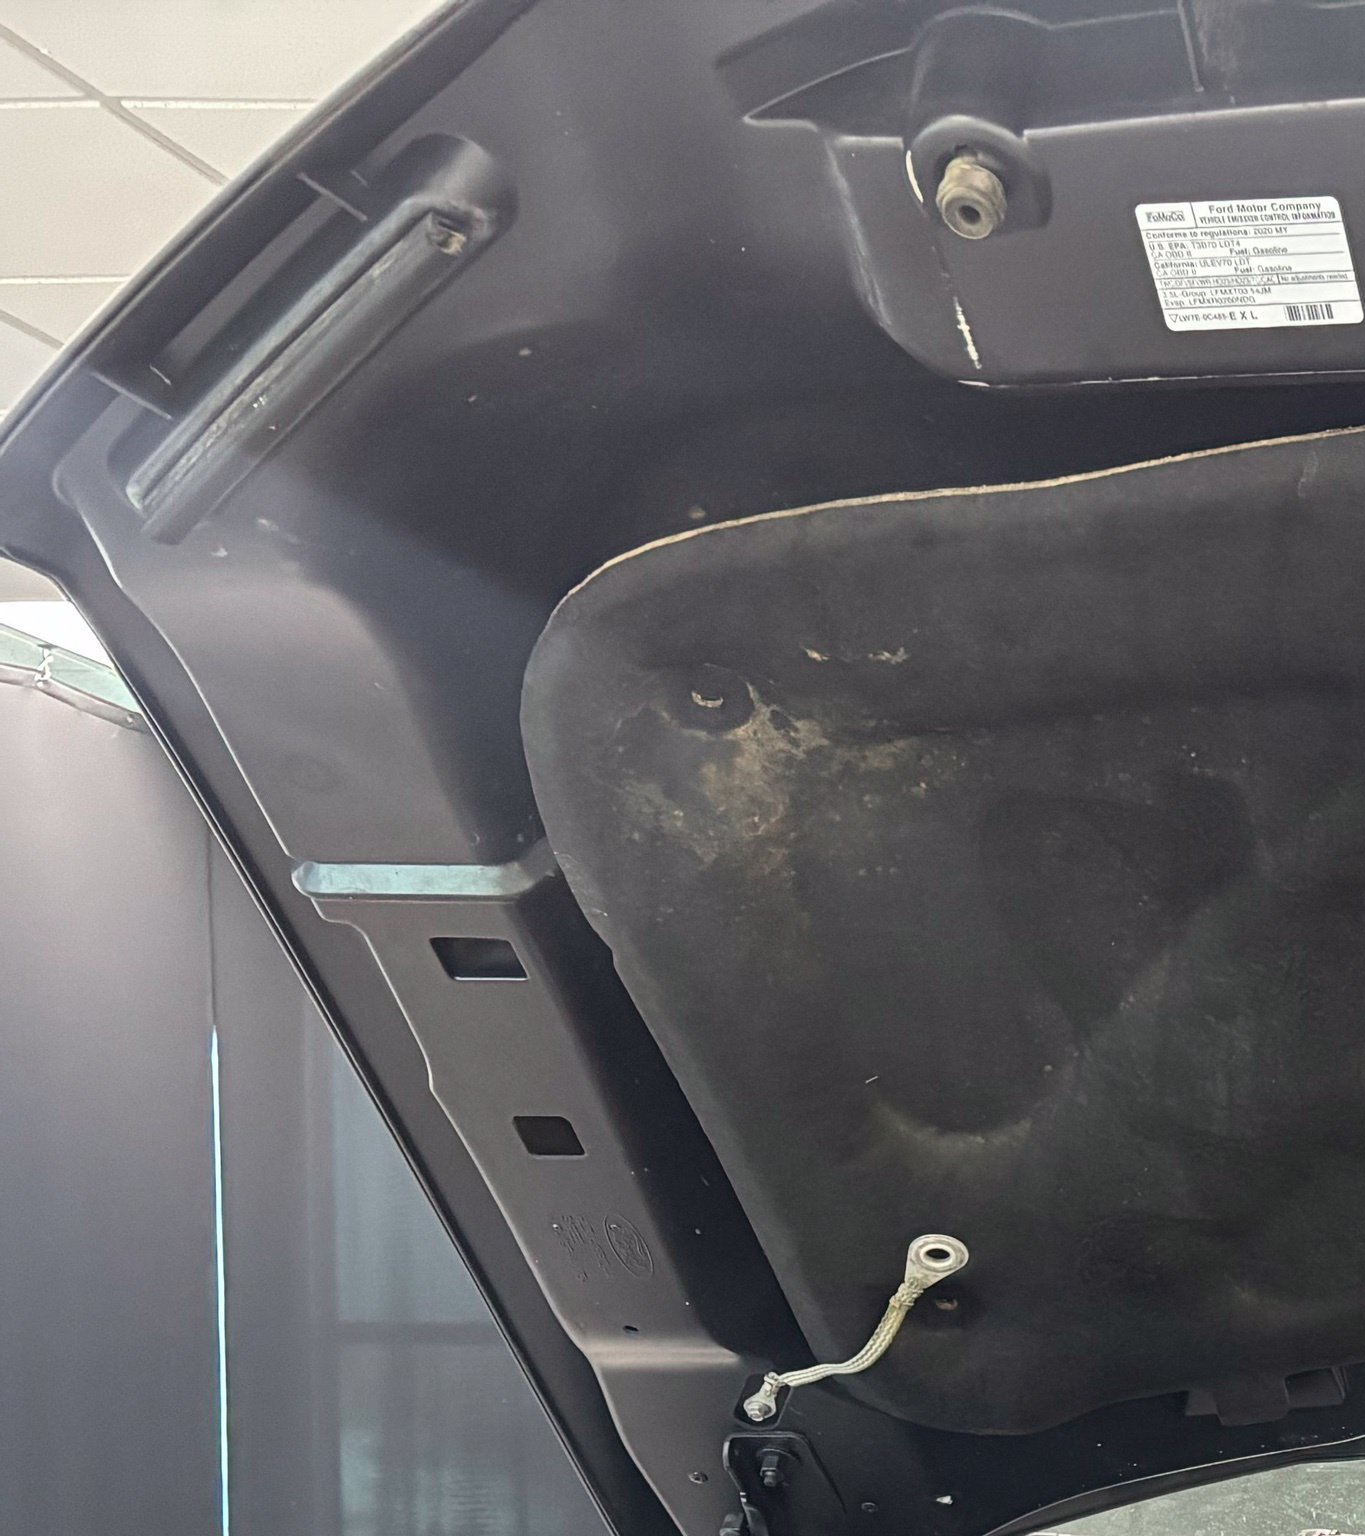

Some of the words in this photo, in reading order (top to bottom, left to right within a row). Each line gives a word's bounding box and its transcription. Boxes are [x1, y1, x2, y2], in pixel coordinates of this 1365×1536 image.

[1208, 204, 1233, 214] Ford
[1237, 203, 1267, 213] Motor
[1271, 201, 1321, 214] Company
